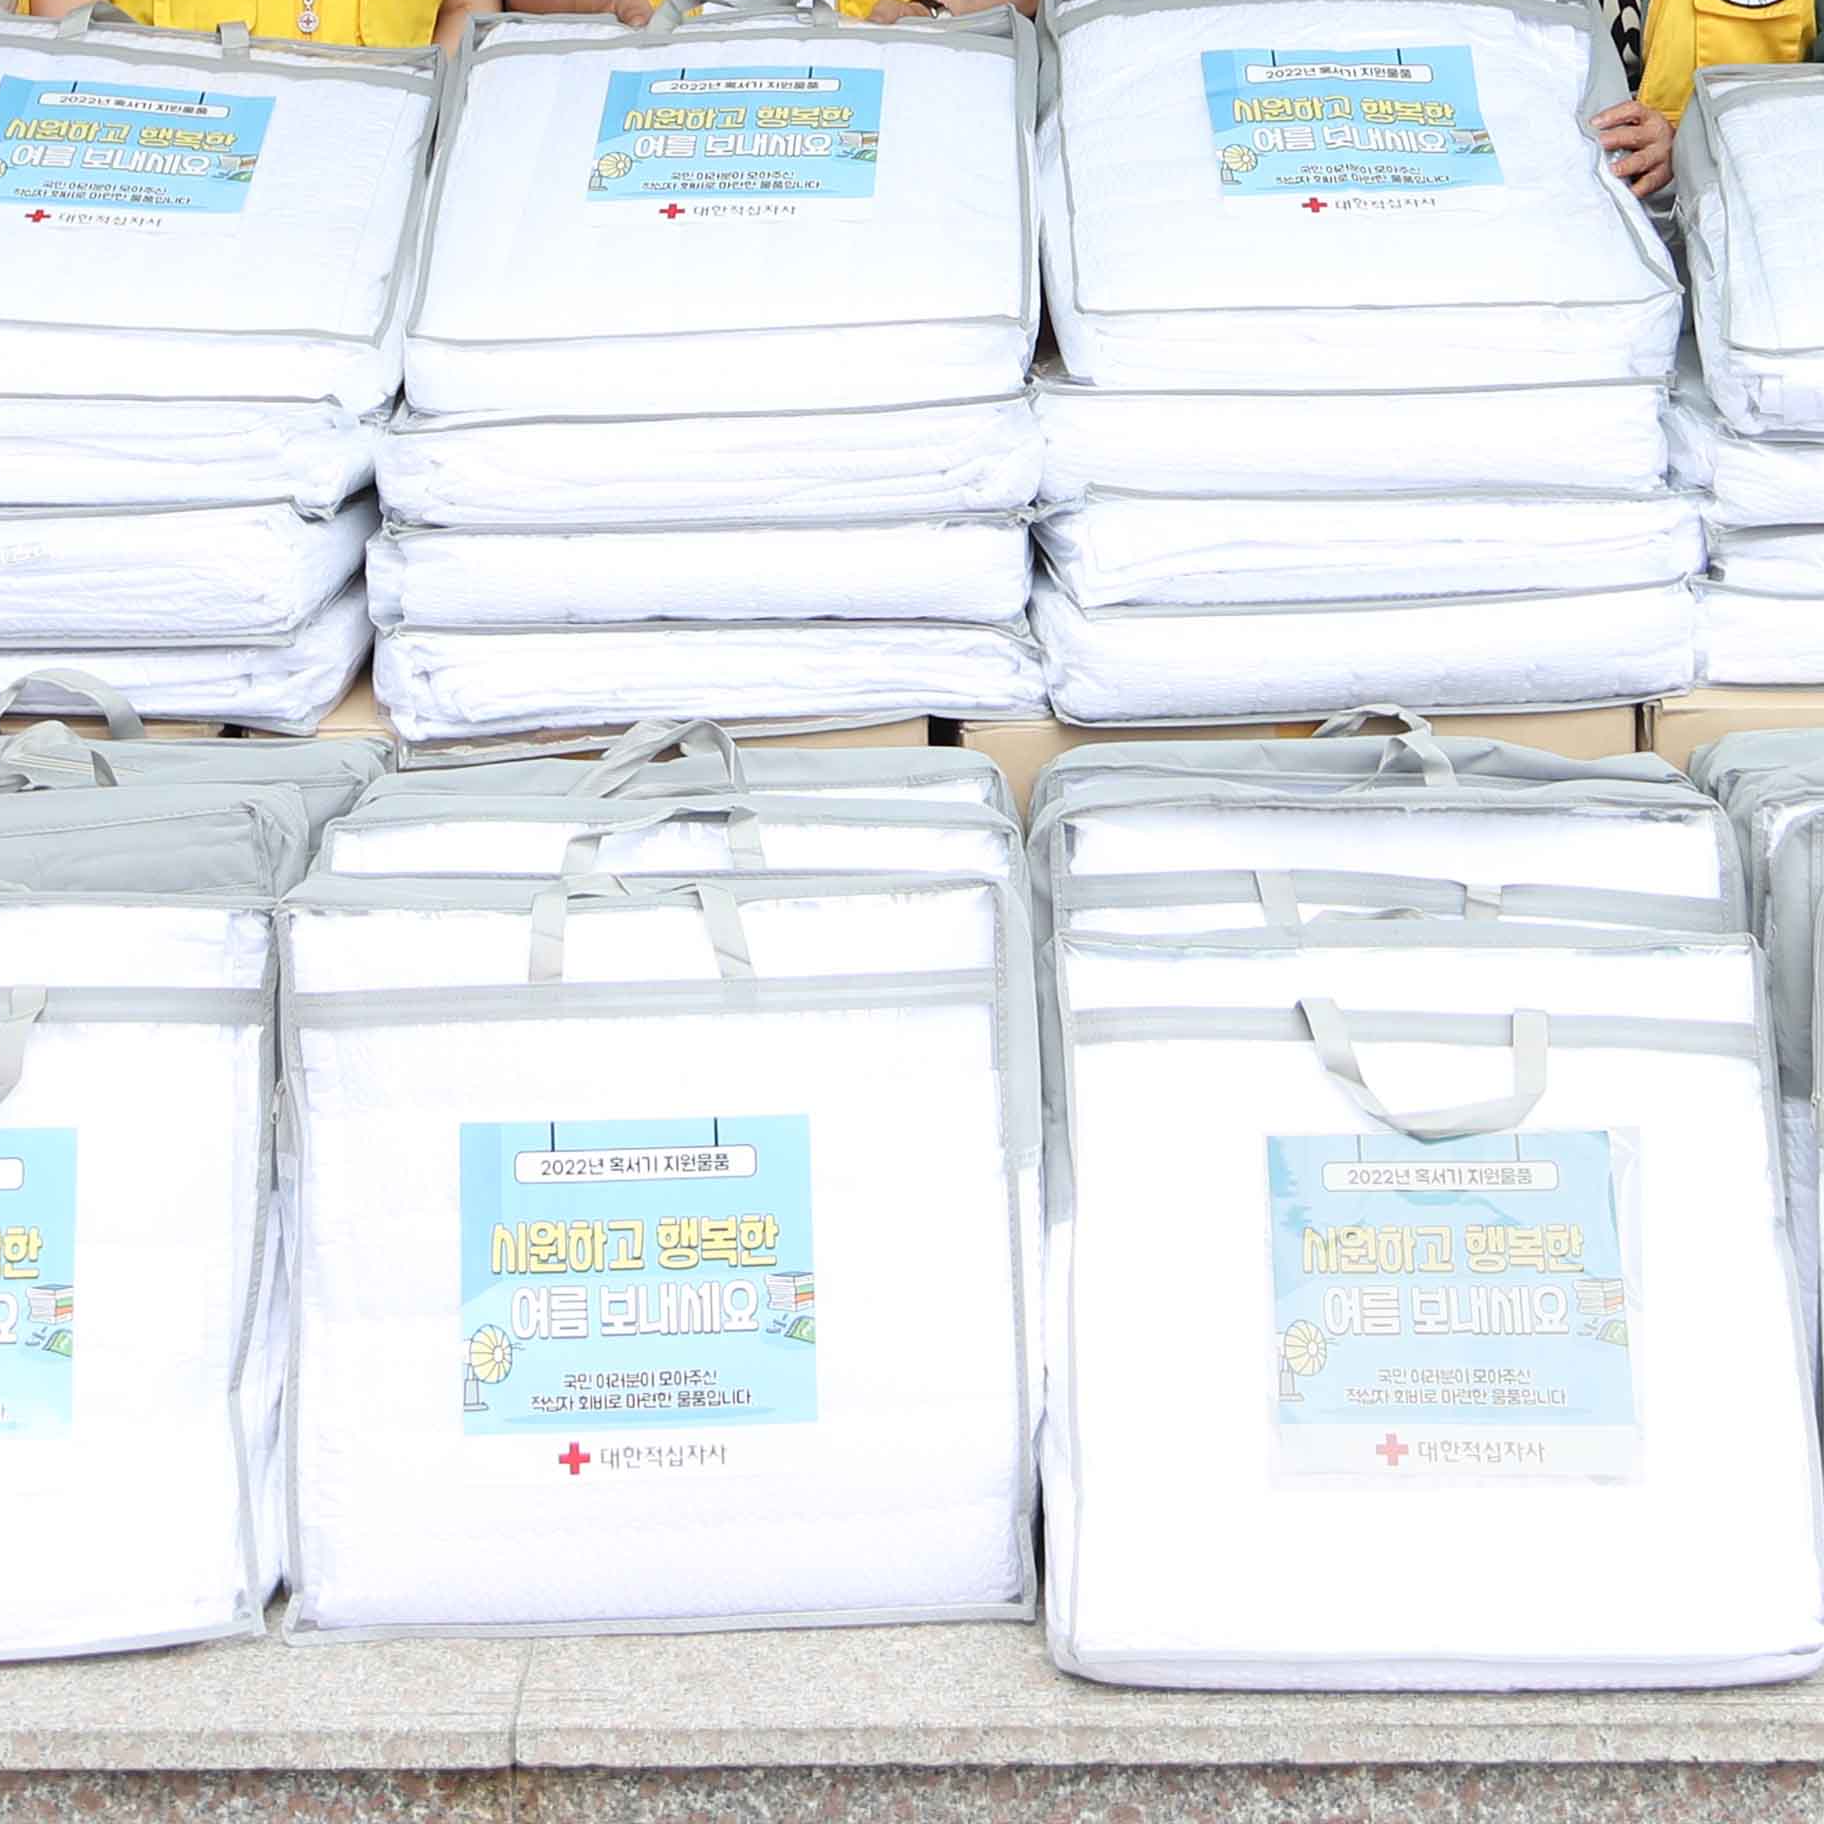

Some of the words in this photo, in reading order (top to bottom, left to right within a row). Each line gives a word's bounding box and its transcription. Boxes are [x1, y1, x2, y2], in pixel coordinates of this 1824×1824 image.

[1232, 96, 1354, 124] 시원하고
[1360, 98, 1457, 127] 행복한
[1252, 127, 1316, 153] 여름
[1323, 125, 1449, 154] 보내세요
[540, 1158, 604, 1177] 2022년
[609, 1156, 658, 1174] 혹서기
[663, 1152, 730, 1172] 지원물품
[490, 1219, 645, 1274] 시원하고
[656, 1215, 780, 1270] 행복한
[1303, 1226, 1455, 1274] 시원하고
[1464, 1224, 1585, 1274] 행복한
[510, 1285, 588, 1339] 여름
[599, 1280, 759, 1337] 보내세요
[1323, 1285, 1401, 1336] 여름
[1411, 1285, 1570, 1335] 보내세요
[563, 1374, 592, 1391] 국민
[596, 1372, 656, 1389] 여러분이
[659, 1370, 718, 1387] 모아주신
[531, 1395, 574, 1411] 적십자
[578, 1393, 622, 1411] 회비로
[626, 1392, 672, 1409] 마련한
[677, 1389, 752, 1407] 물품입니다
[600, 1444, 727, 1470] 대한적십자사
